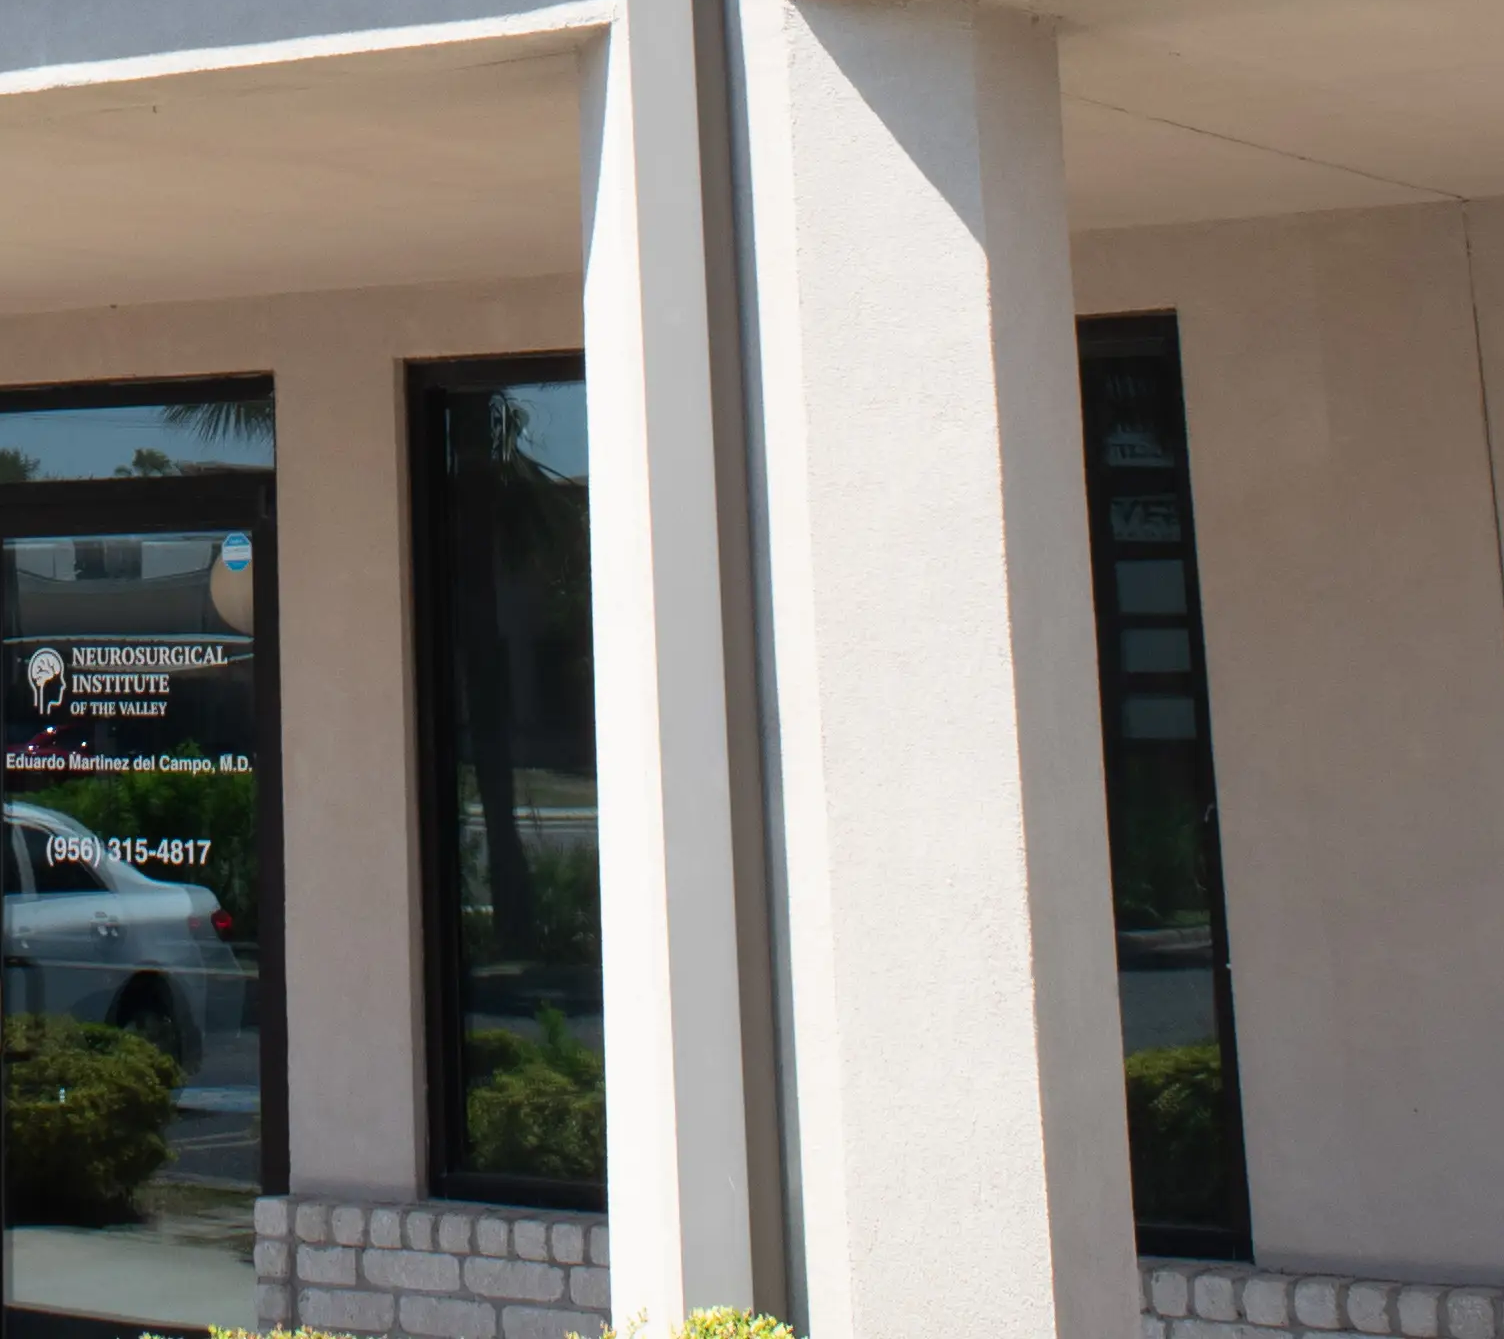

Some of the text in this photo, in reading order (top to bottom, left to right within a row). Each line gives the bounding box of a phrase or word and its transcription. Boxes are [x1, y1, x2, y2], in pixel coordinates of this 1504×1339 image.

[71, 645, 228, 666] NEUROSURGICAL
[71, 674, 170, 694] INSTITUTE
[70, 701, 168, 717] OF THE VALLEY
[6, 752, 253, 777] Eduardo Martinez del Campo, M.D.
[46, 834, 212, 867] (956) 315-4817
